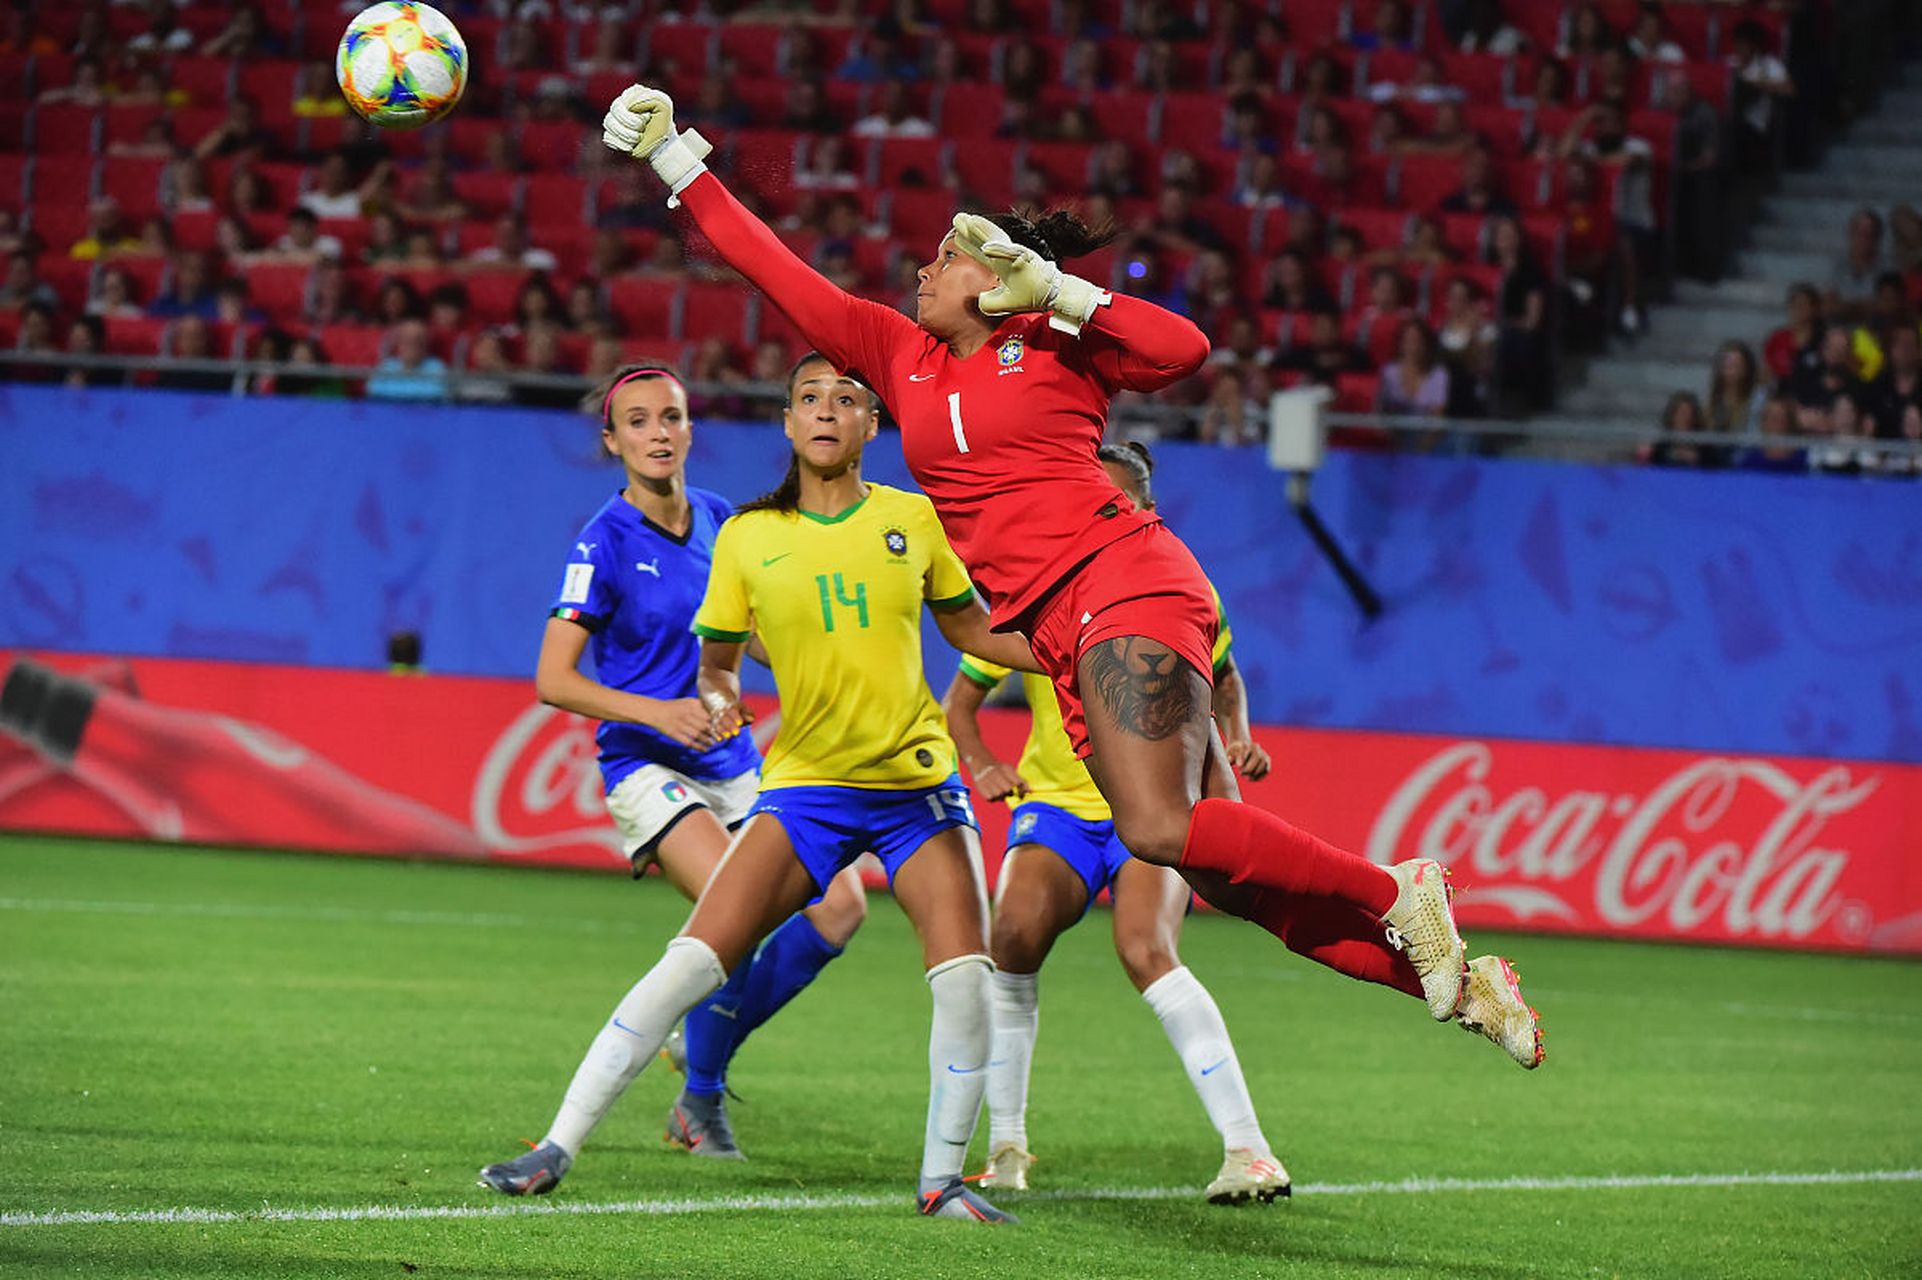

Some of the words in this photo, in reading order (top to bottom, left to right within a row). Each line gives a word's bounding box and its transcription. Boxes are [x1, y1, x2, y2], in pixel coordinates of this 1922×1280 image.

[947, 392, 970, 454] 1
[815, 571, 870, 632] 14
[926, 790, 976, 827] 14
